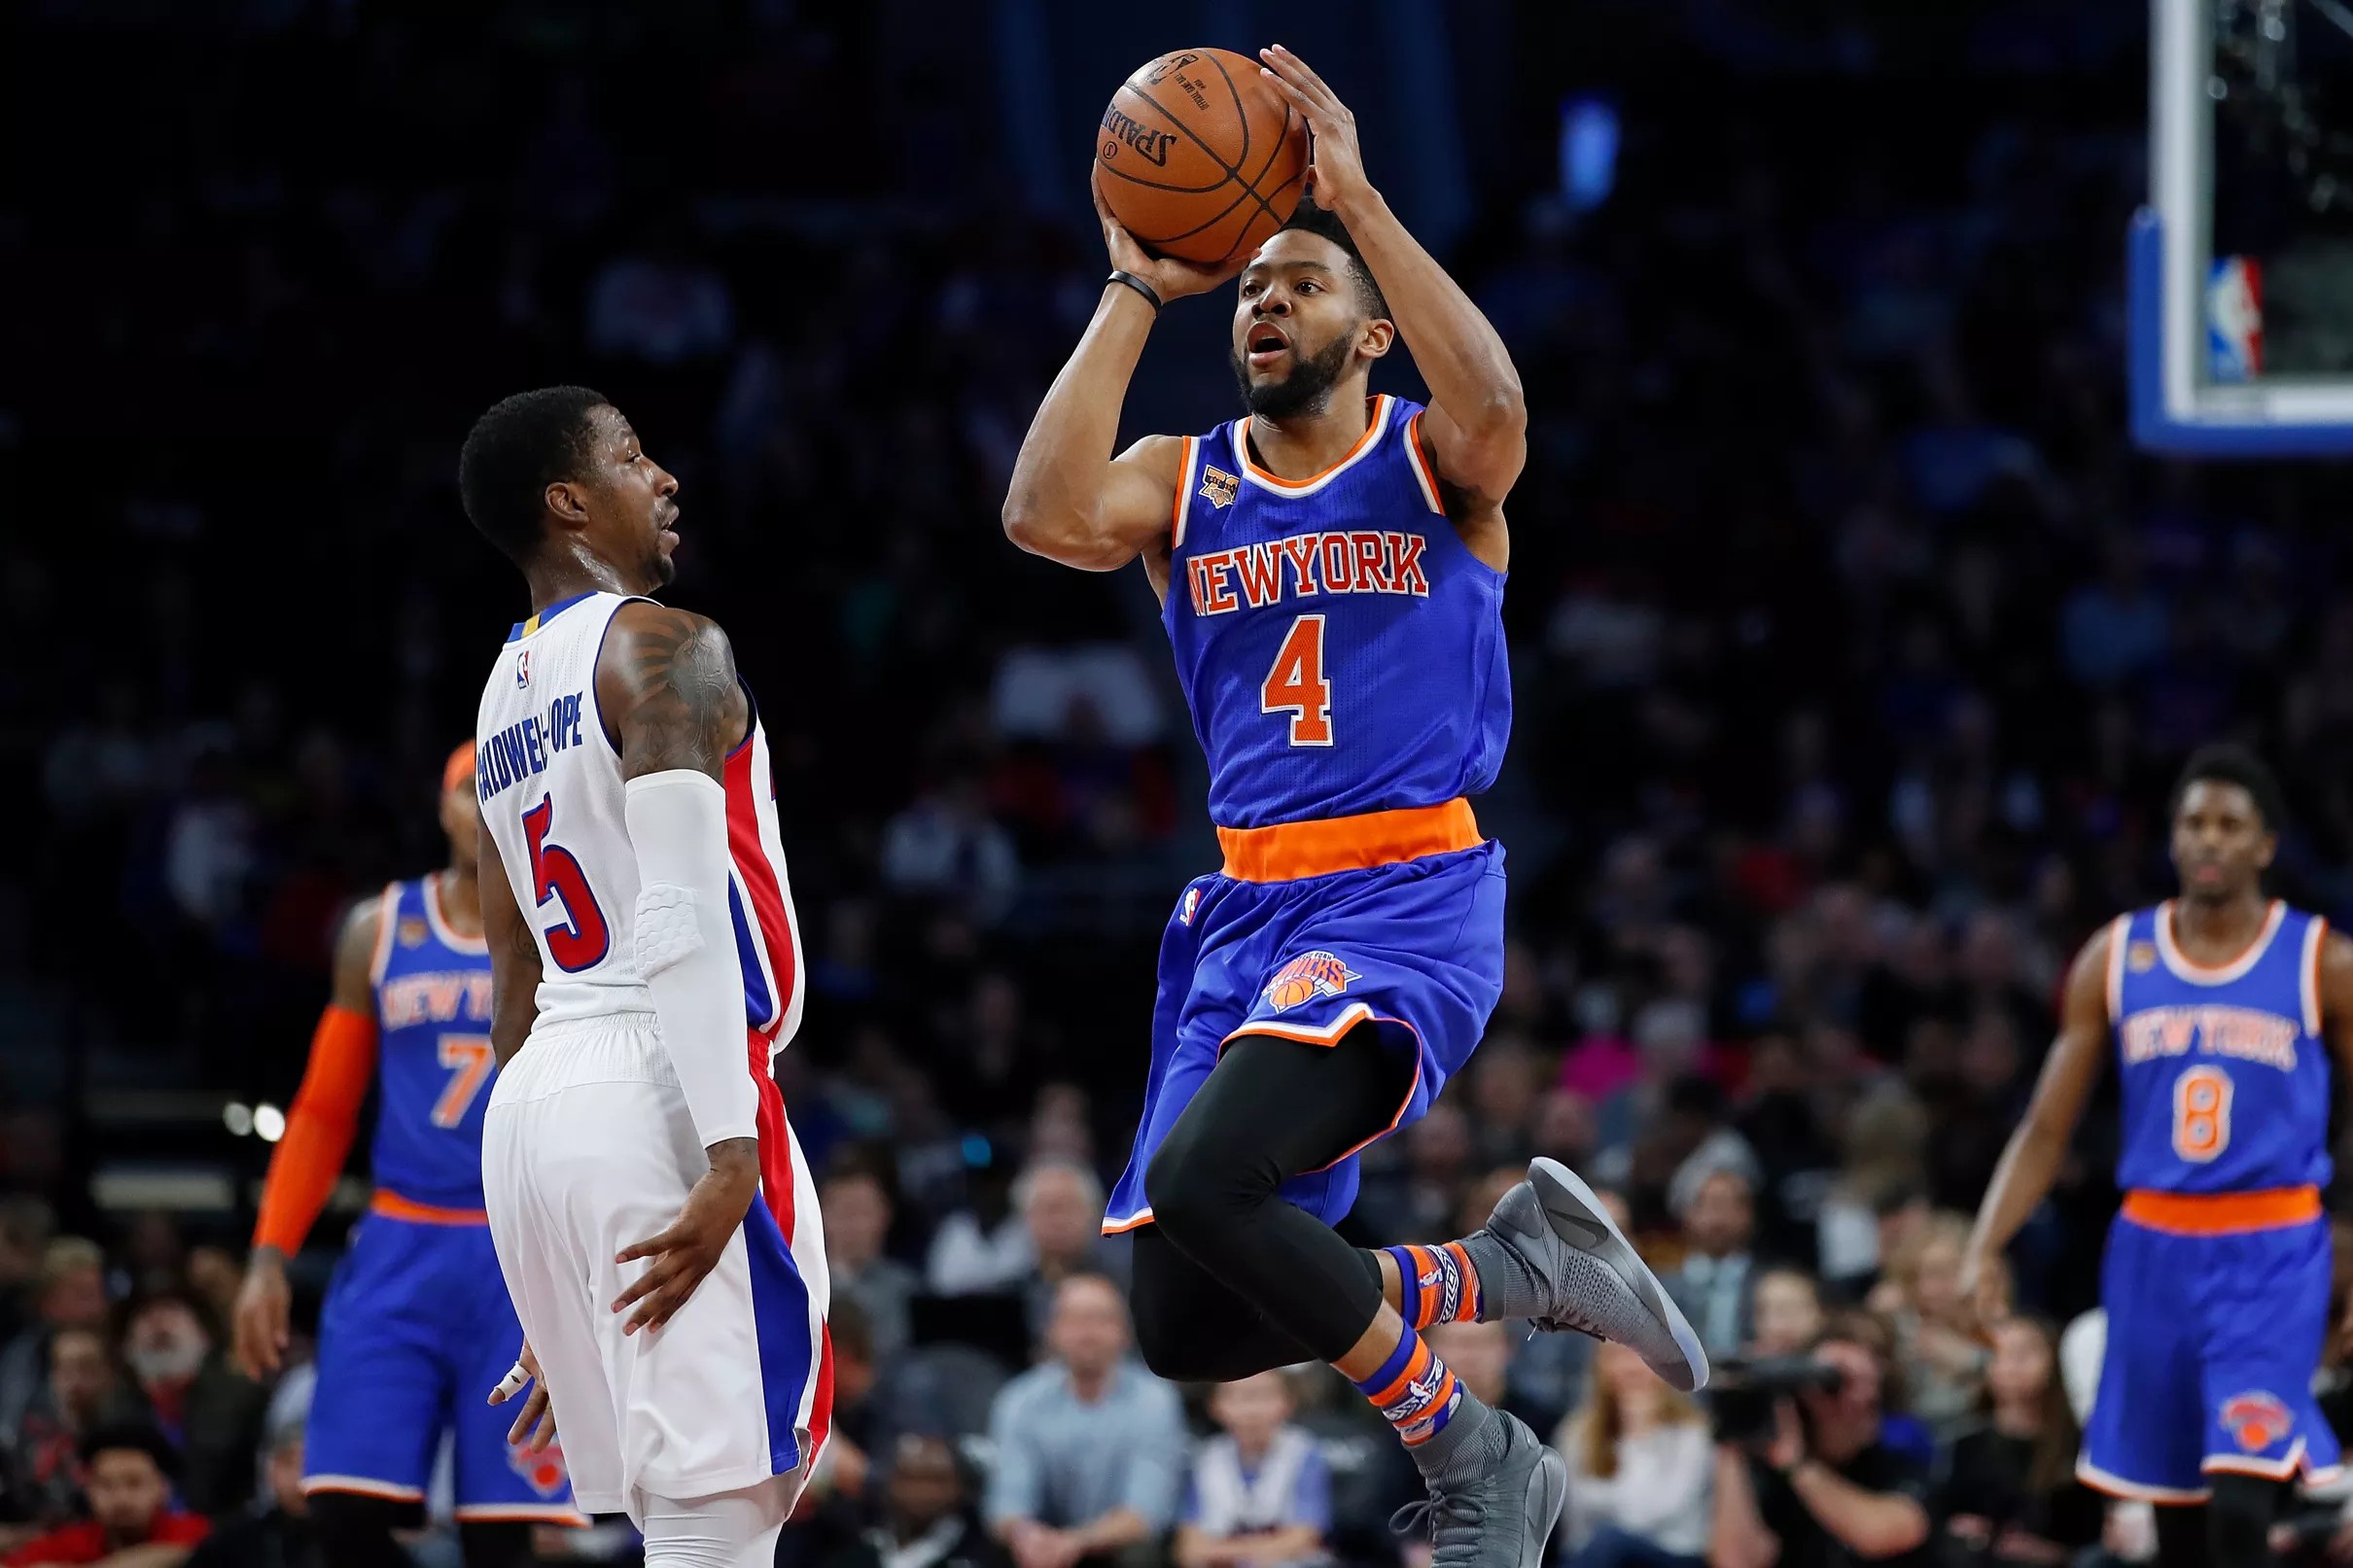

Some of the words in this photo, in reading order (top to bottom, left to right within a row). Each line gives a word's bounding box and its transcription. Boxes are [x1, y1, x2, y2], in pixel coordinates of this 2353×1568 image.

[1102, 104, 1176, 167] SPALDI
[1261, 613, 1334, 747] 4
[521, 790, 610, 973] 5
[431, 1032, 495, 1129] 7
[2172, 1064, 2234, 1164] 8
